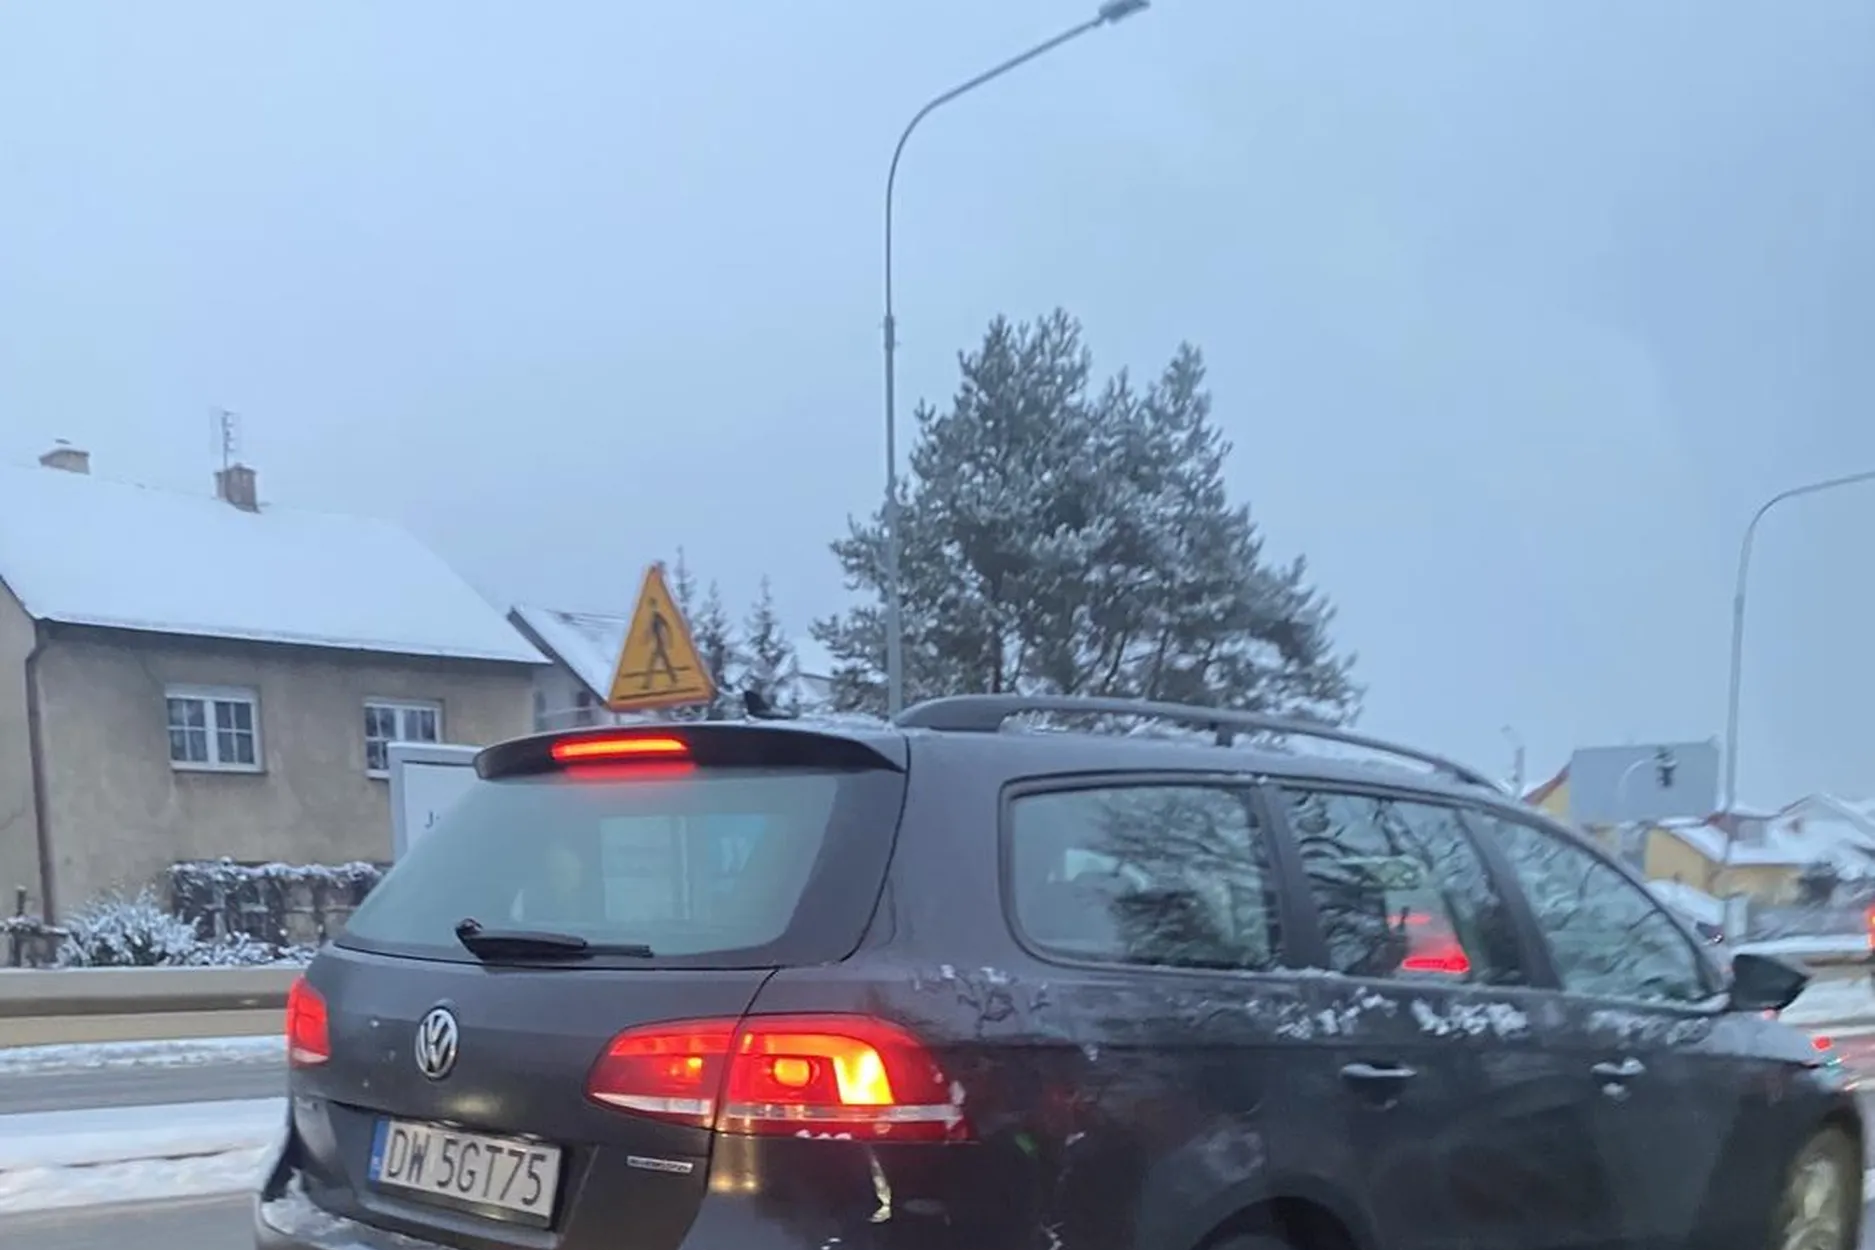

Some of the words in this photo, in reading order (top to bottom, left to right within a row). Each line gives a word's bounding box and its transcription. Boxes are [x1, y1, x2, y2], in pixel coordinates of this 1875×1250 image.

[416, 1008, 458, 1078] VW
[387, 1129, 432, 1184] DW
[436, 1138, 547, 1206] 5GT75
